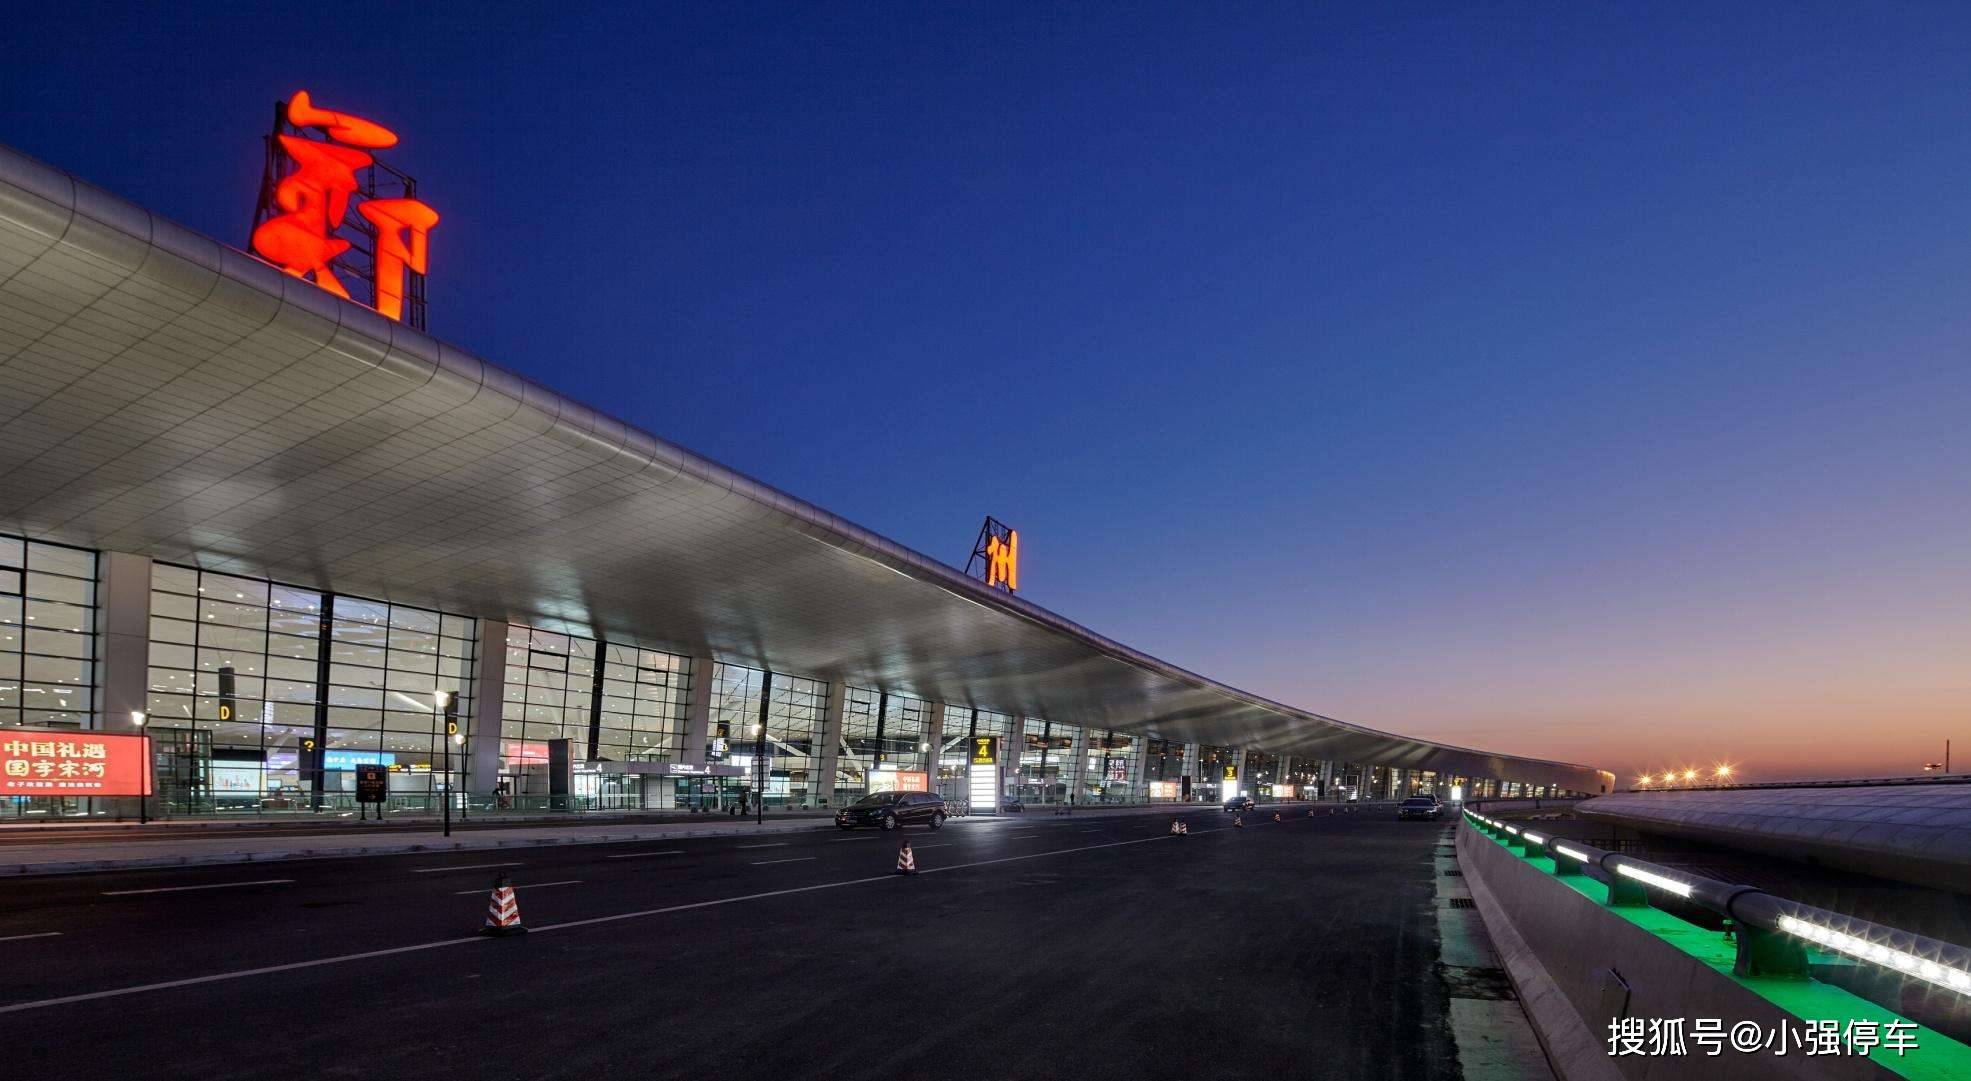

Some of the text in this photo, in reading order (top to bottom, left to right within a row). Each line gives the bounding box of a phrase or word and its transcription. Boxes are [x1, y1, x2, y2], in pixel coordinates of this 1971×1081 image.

[988, 530, 1018, 590] 州
[220, 705, 230, 720] D
[448, 722, 458, 734] D
[4, 740, 106, 759] 中国礼遇
[978, 745, 988, 757] 4
[596, 762, 603, 773] 4
[704, 765, 711, 775] 4
